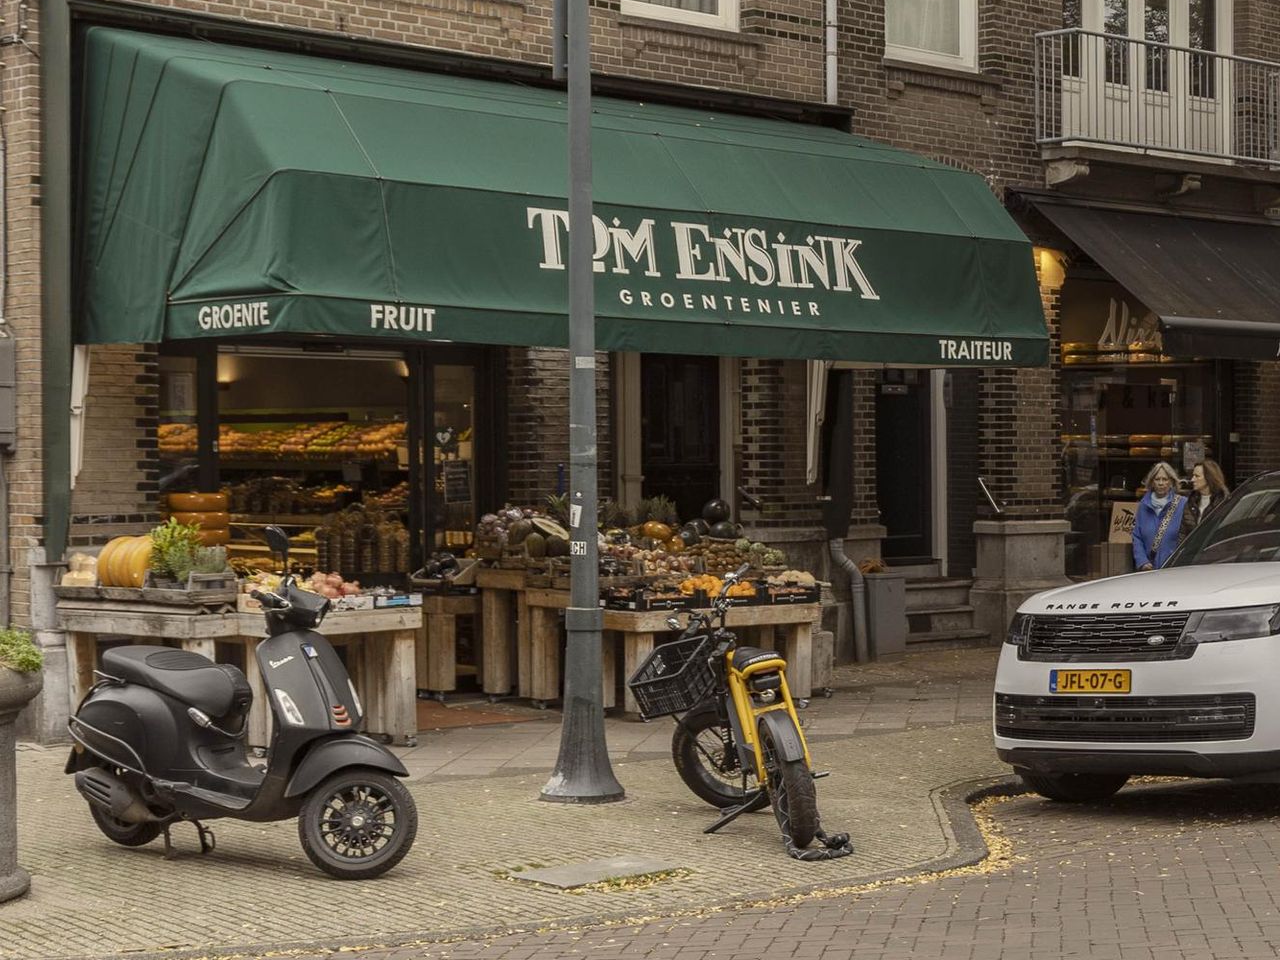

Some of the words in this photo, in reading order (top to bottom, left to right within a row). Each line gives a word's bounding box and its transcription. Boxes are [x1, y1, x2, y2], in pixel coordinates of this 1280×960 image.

[620, 289, 821, 316] GROENTENIER
[198, 301, 271, 330] GROENTE
[369, 304, 436, 332] FRUIT
[938, 339, 1013, 361] TRAITEUR
[1111, 601, 1178, 609] ROVER
[1062, 673, 1123, 690] JFL-07-G
